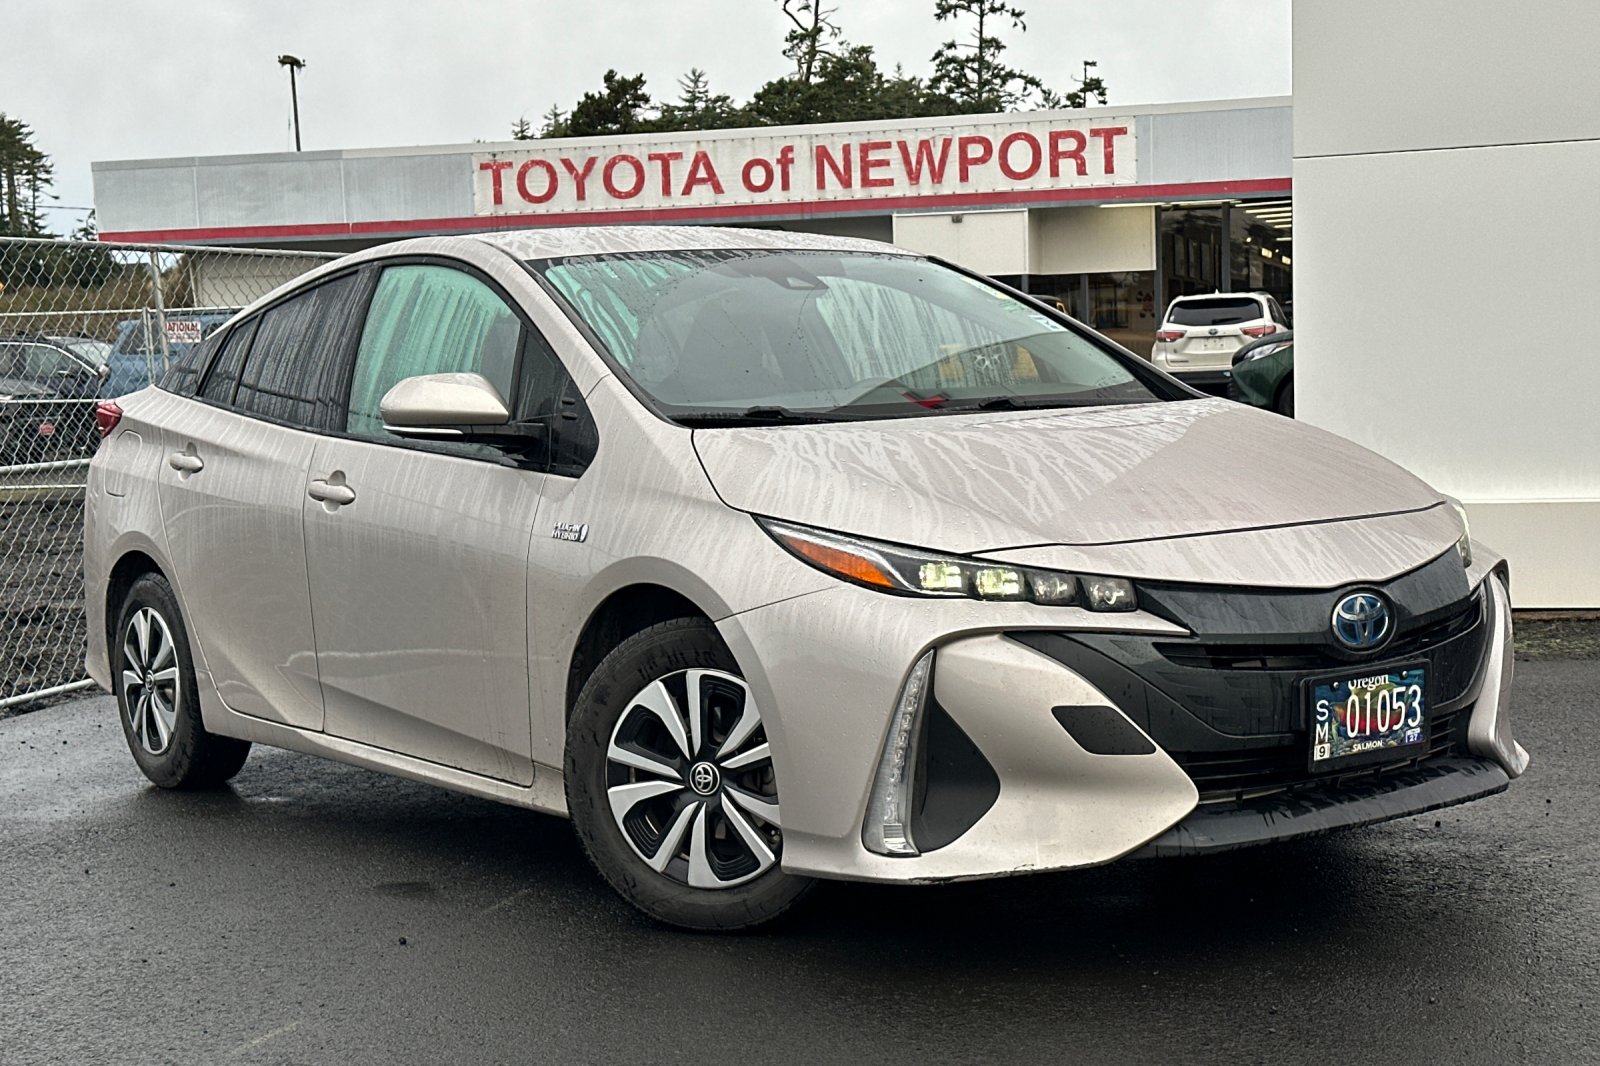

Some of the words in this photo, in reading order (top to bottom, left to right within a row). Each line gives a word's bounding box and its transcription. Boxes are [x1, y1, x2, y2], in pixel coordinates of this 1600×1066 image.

[480, 150, 725, 205] TOYOTA
[742, 145, 795, 193] of
[815, 127, 1128, 190] NEWPORT
[1348, 674, 1389, 690] Oregon
[1346, 685, 1421, 738] 01053
[1319, 746, 1326, 757] 9
[1352, 740, 1383, 752] SALMON
